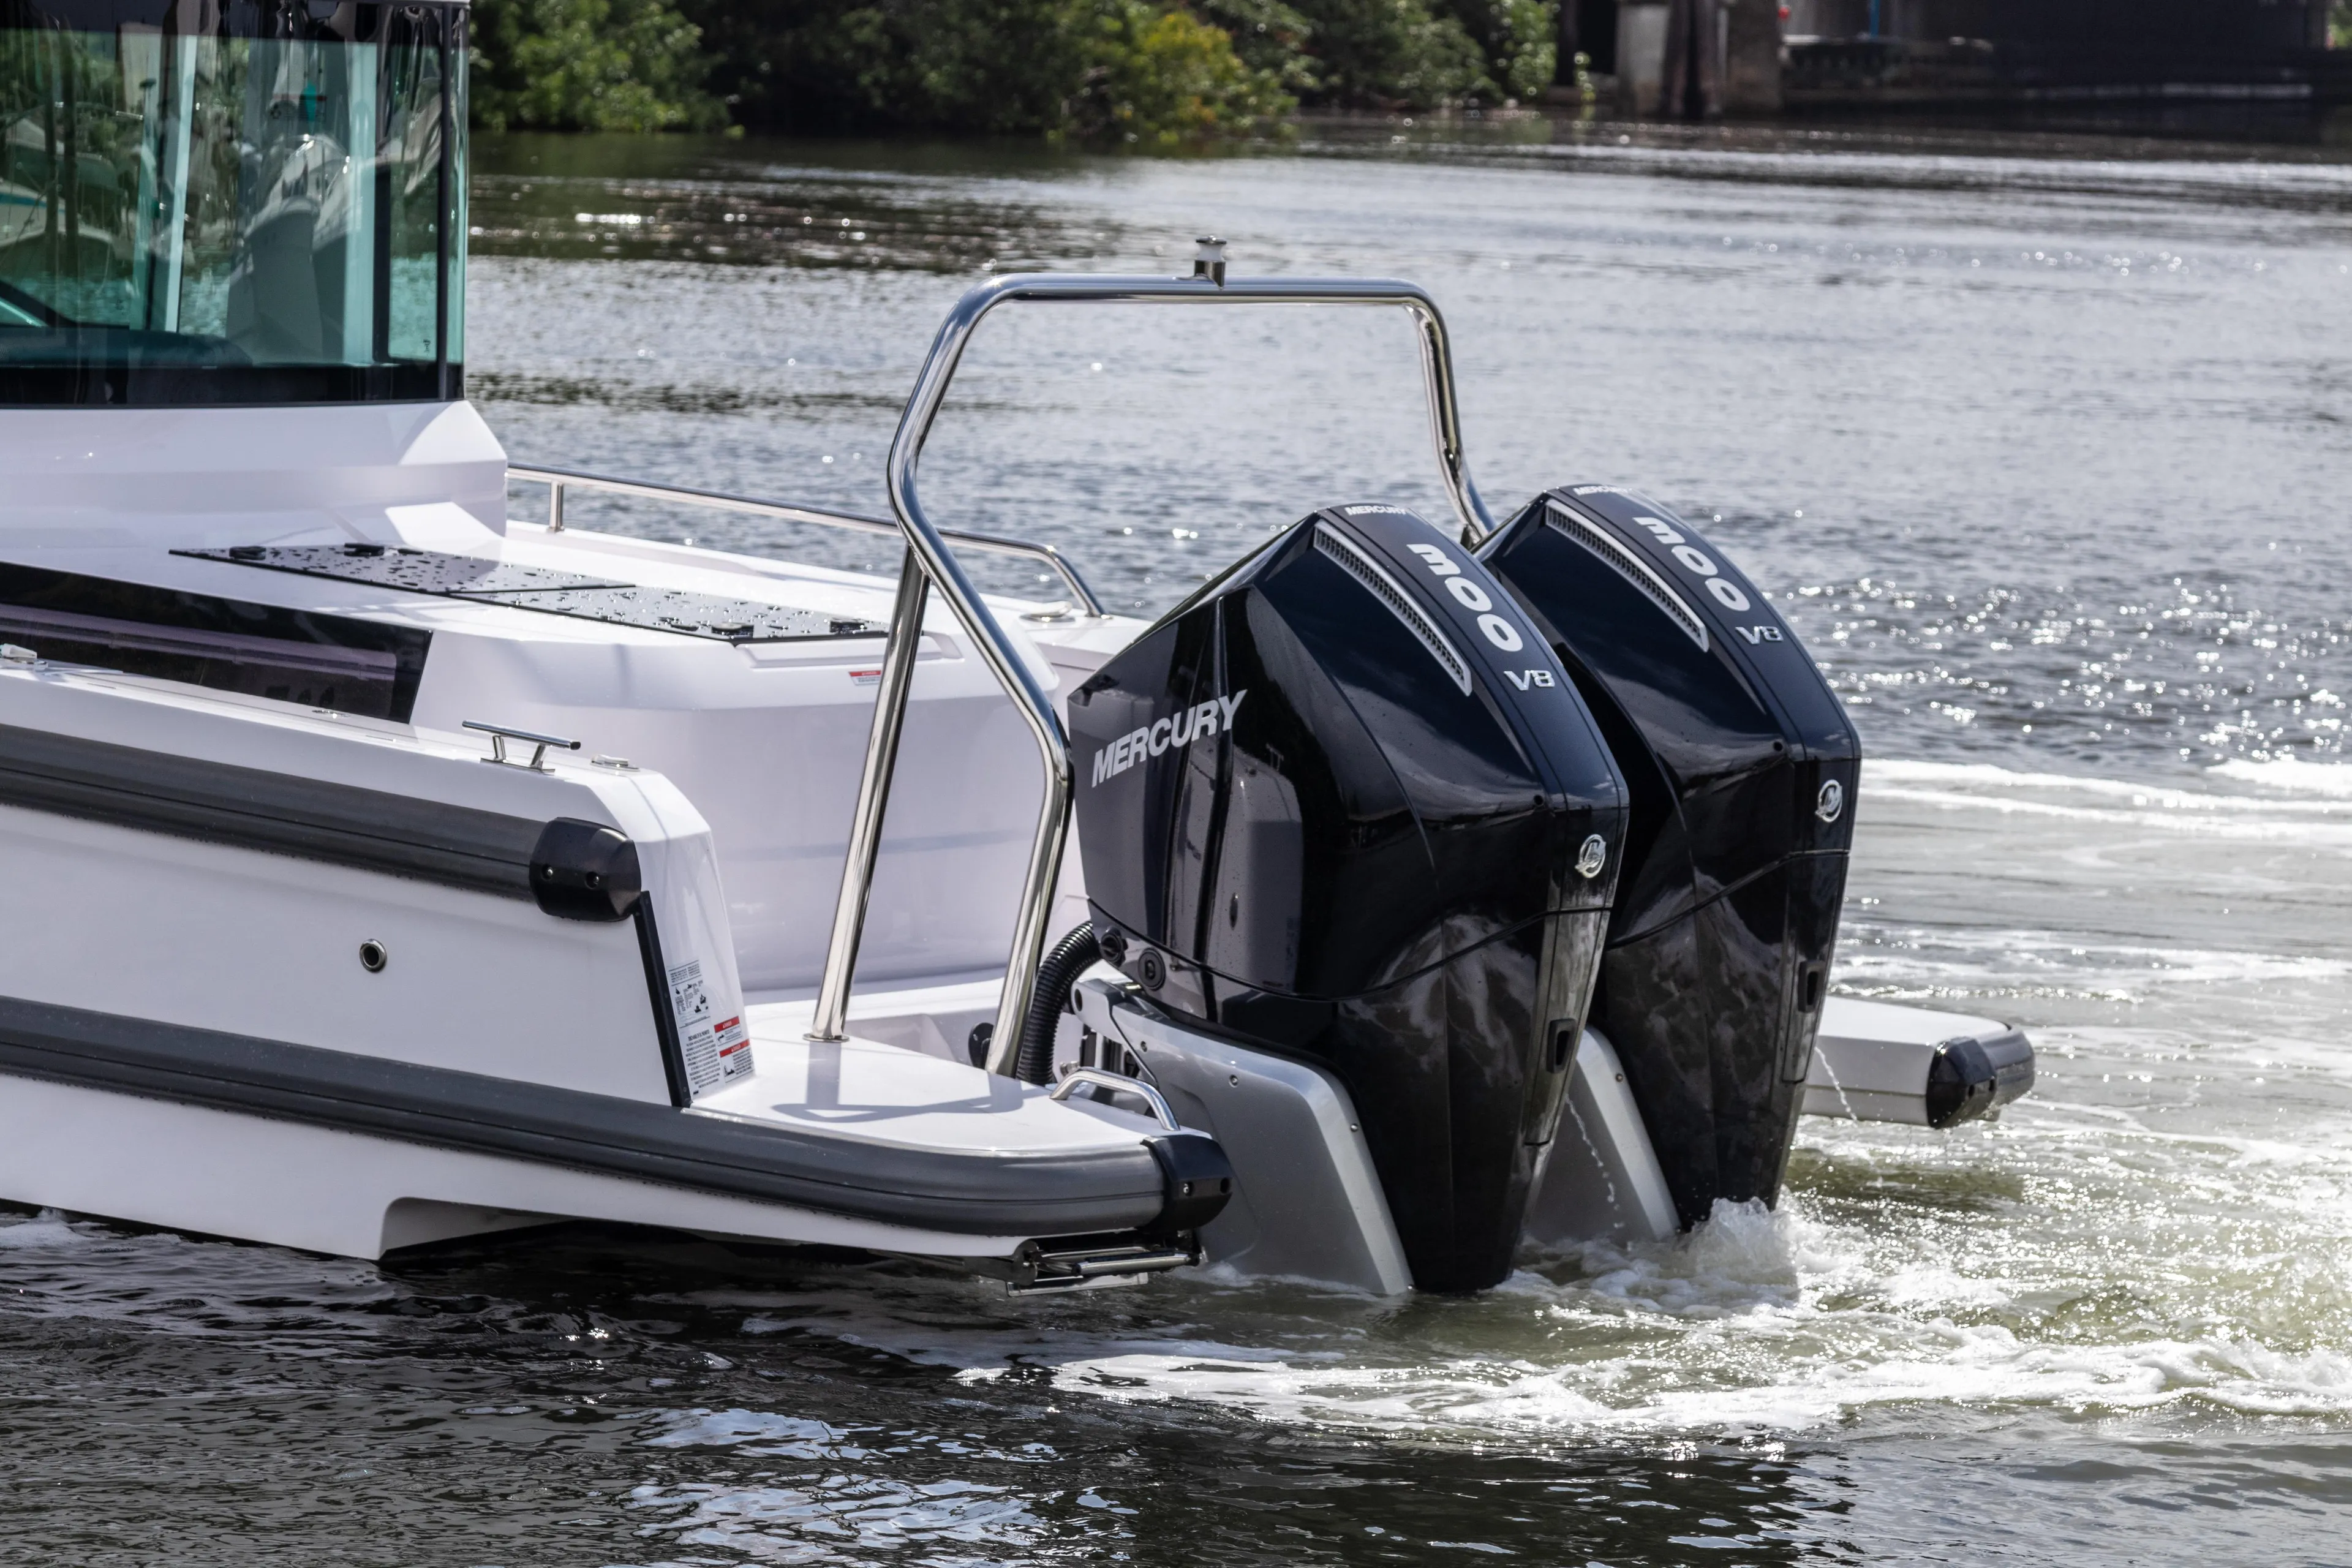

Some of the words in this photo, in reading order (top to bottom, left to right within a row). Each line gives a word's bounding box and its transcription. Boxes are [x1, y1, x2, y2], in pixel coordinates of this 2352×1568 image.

[1344, 505, 1407, 516] MERCURY
[1406, 543, 1523, 652] 300
[1504, 669, 1556, 691] V8
[1632, 517, 1751, 611] 300
[1735, 626, 1784, 644] V8
[1091, 688, 1248, 788] MERCURY
